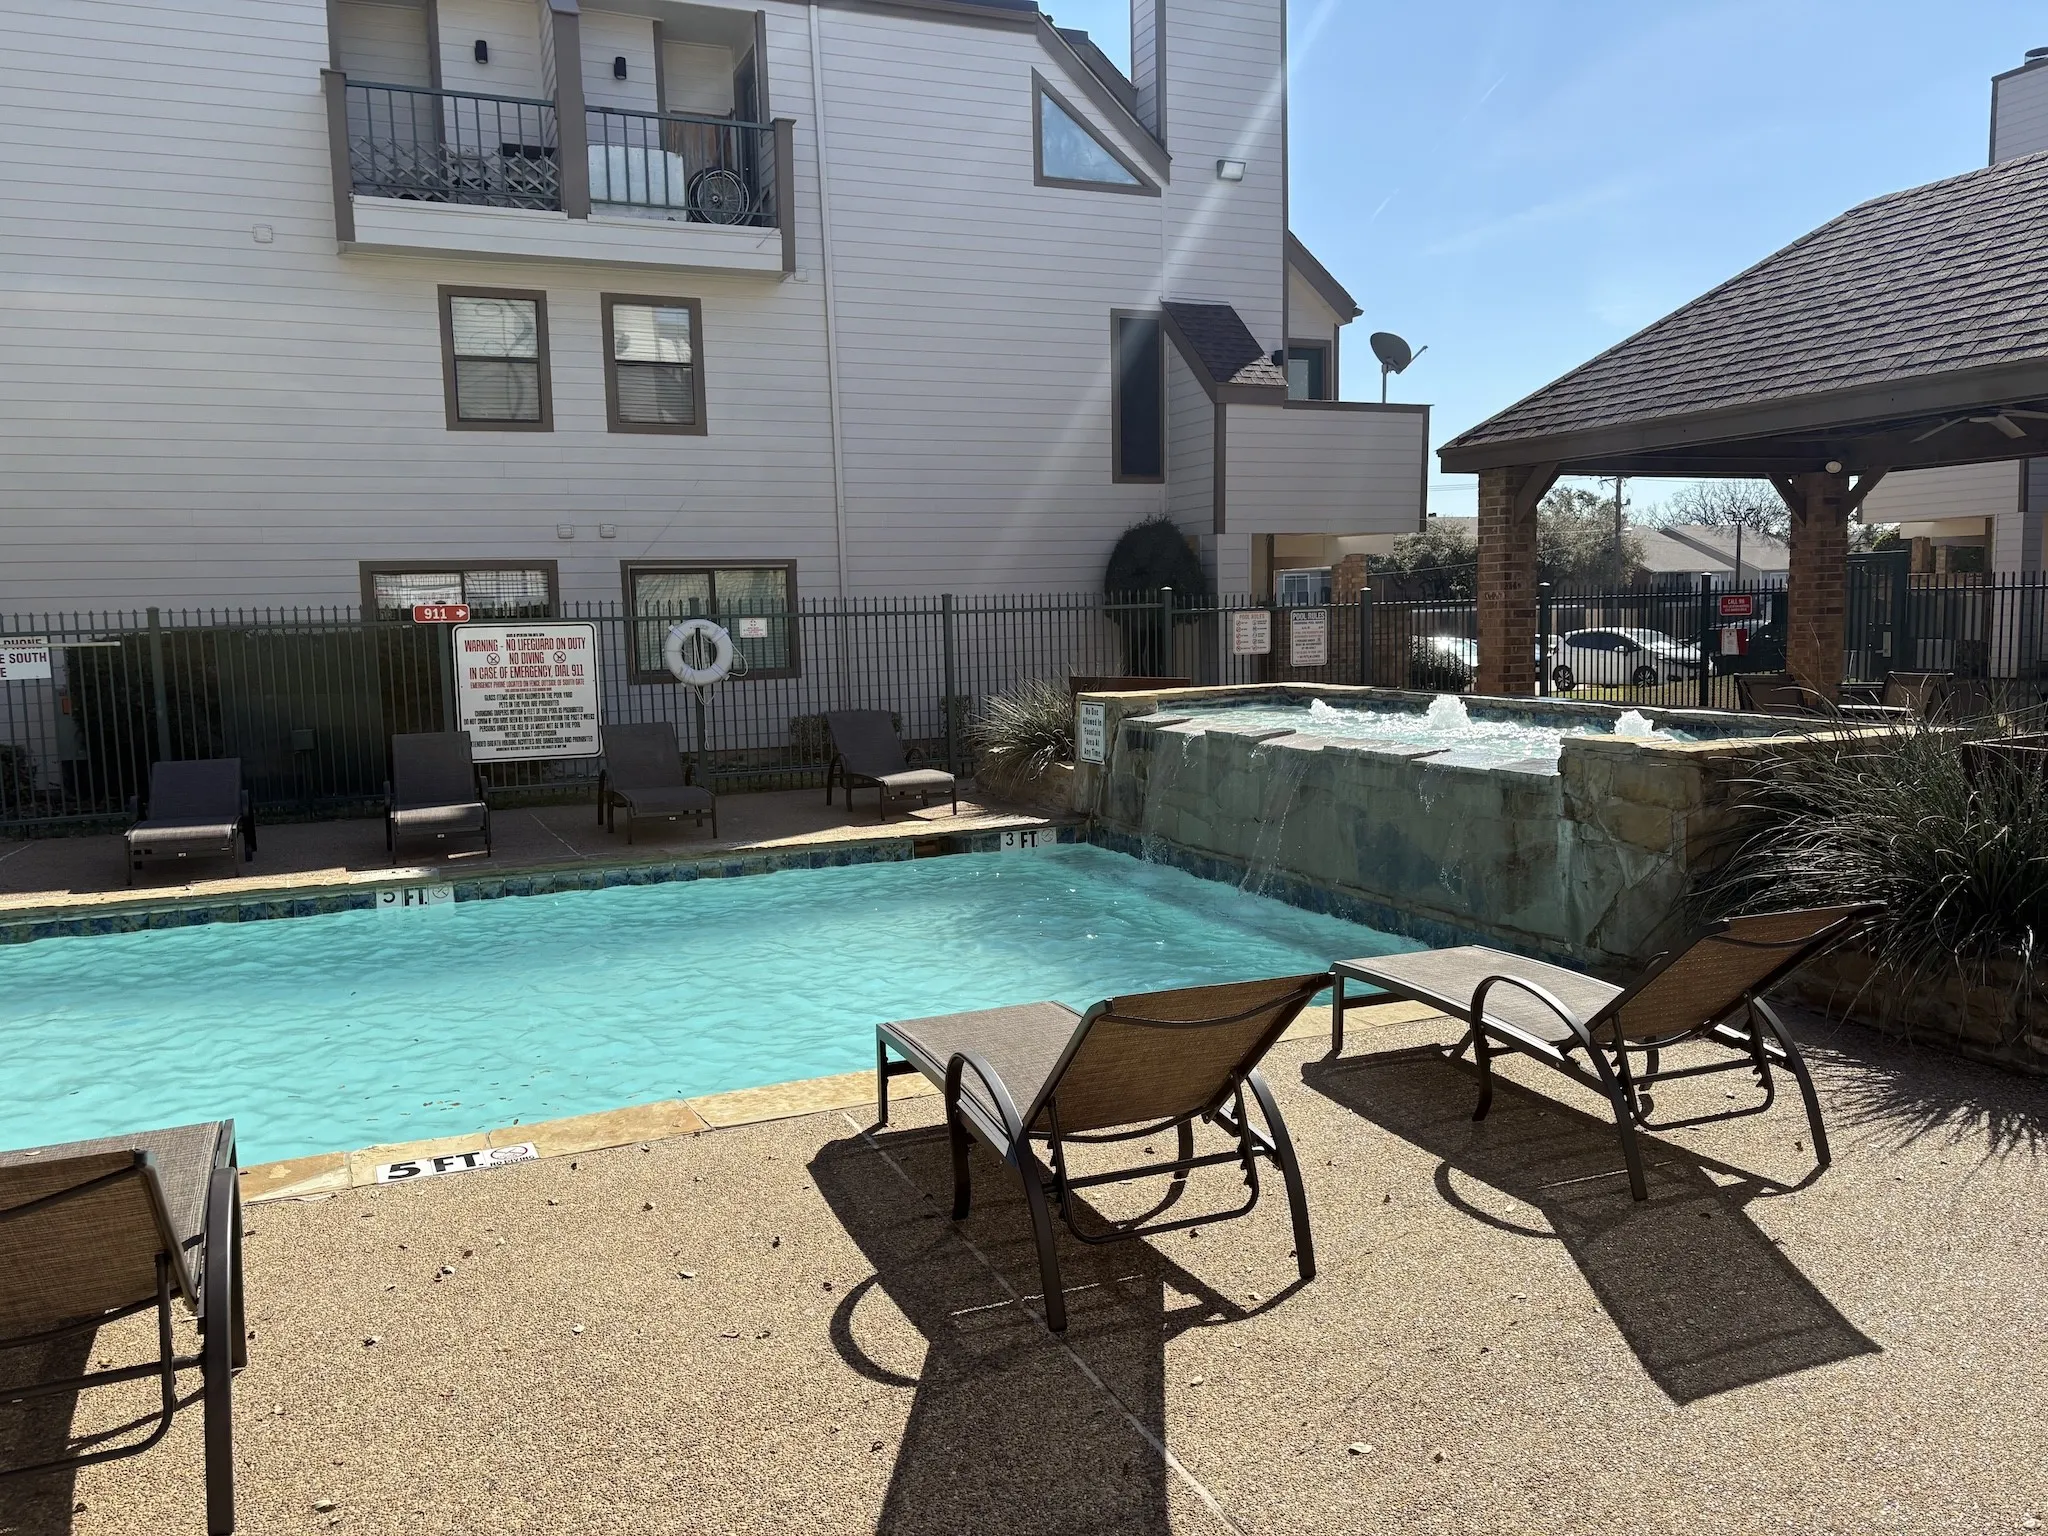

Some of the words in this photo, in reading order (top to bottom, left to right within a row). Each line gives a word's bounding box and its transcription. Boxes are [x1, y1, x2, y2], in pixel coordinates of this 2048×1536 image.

[424, 608, 447, 620] 911
[465, 640, 498, 652] WARNING
[506, 639, 516, 651] NO
[518, 638, 554, 650] LIFEGUARD
[556, 638, 566, 650] ON
[568, 637, 586, 650] DUTY
[9, 652, 47, 664] SOUTH
[509, 653, 519, 664] NO
[521, 652, 544, 664] DIVING
[470, 667, 477, 680] IN
[479, 666, 498, 680] CASE
[500, 666, 508, 678] OF
[510, 665, 554, 678] EMERGENCY,
[555, 664, 570, 676] DIAL
[572, 664, 584, 676] 911
[1086, 707, 1090, 715] No
[1082, 717, 1097, 726] Allowed
[1084, 727, 1100, 736] Fountain
[1086, 738, 1094, 746] Area
[1095, 738, 1100, 746] At
[1006, 832, 1014, 846] 3
[1021, 831, 1038, 848] FT.
[404, 888, 428, 906] FT.
[504, 1154, 535, 1165] DIVING
[388, 1162, 421, 1180] 5
[433, 1152, 484, 1172] FT.
